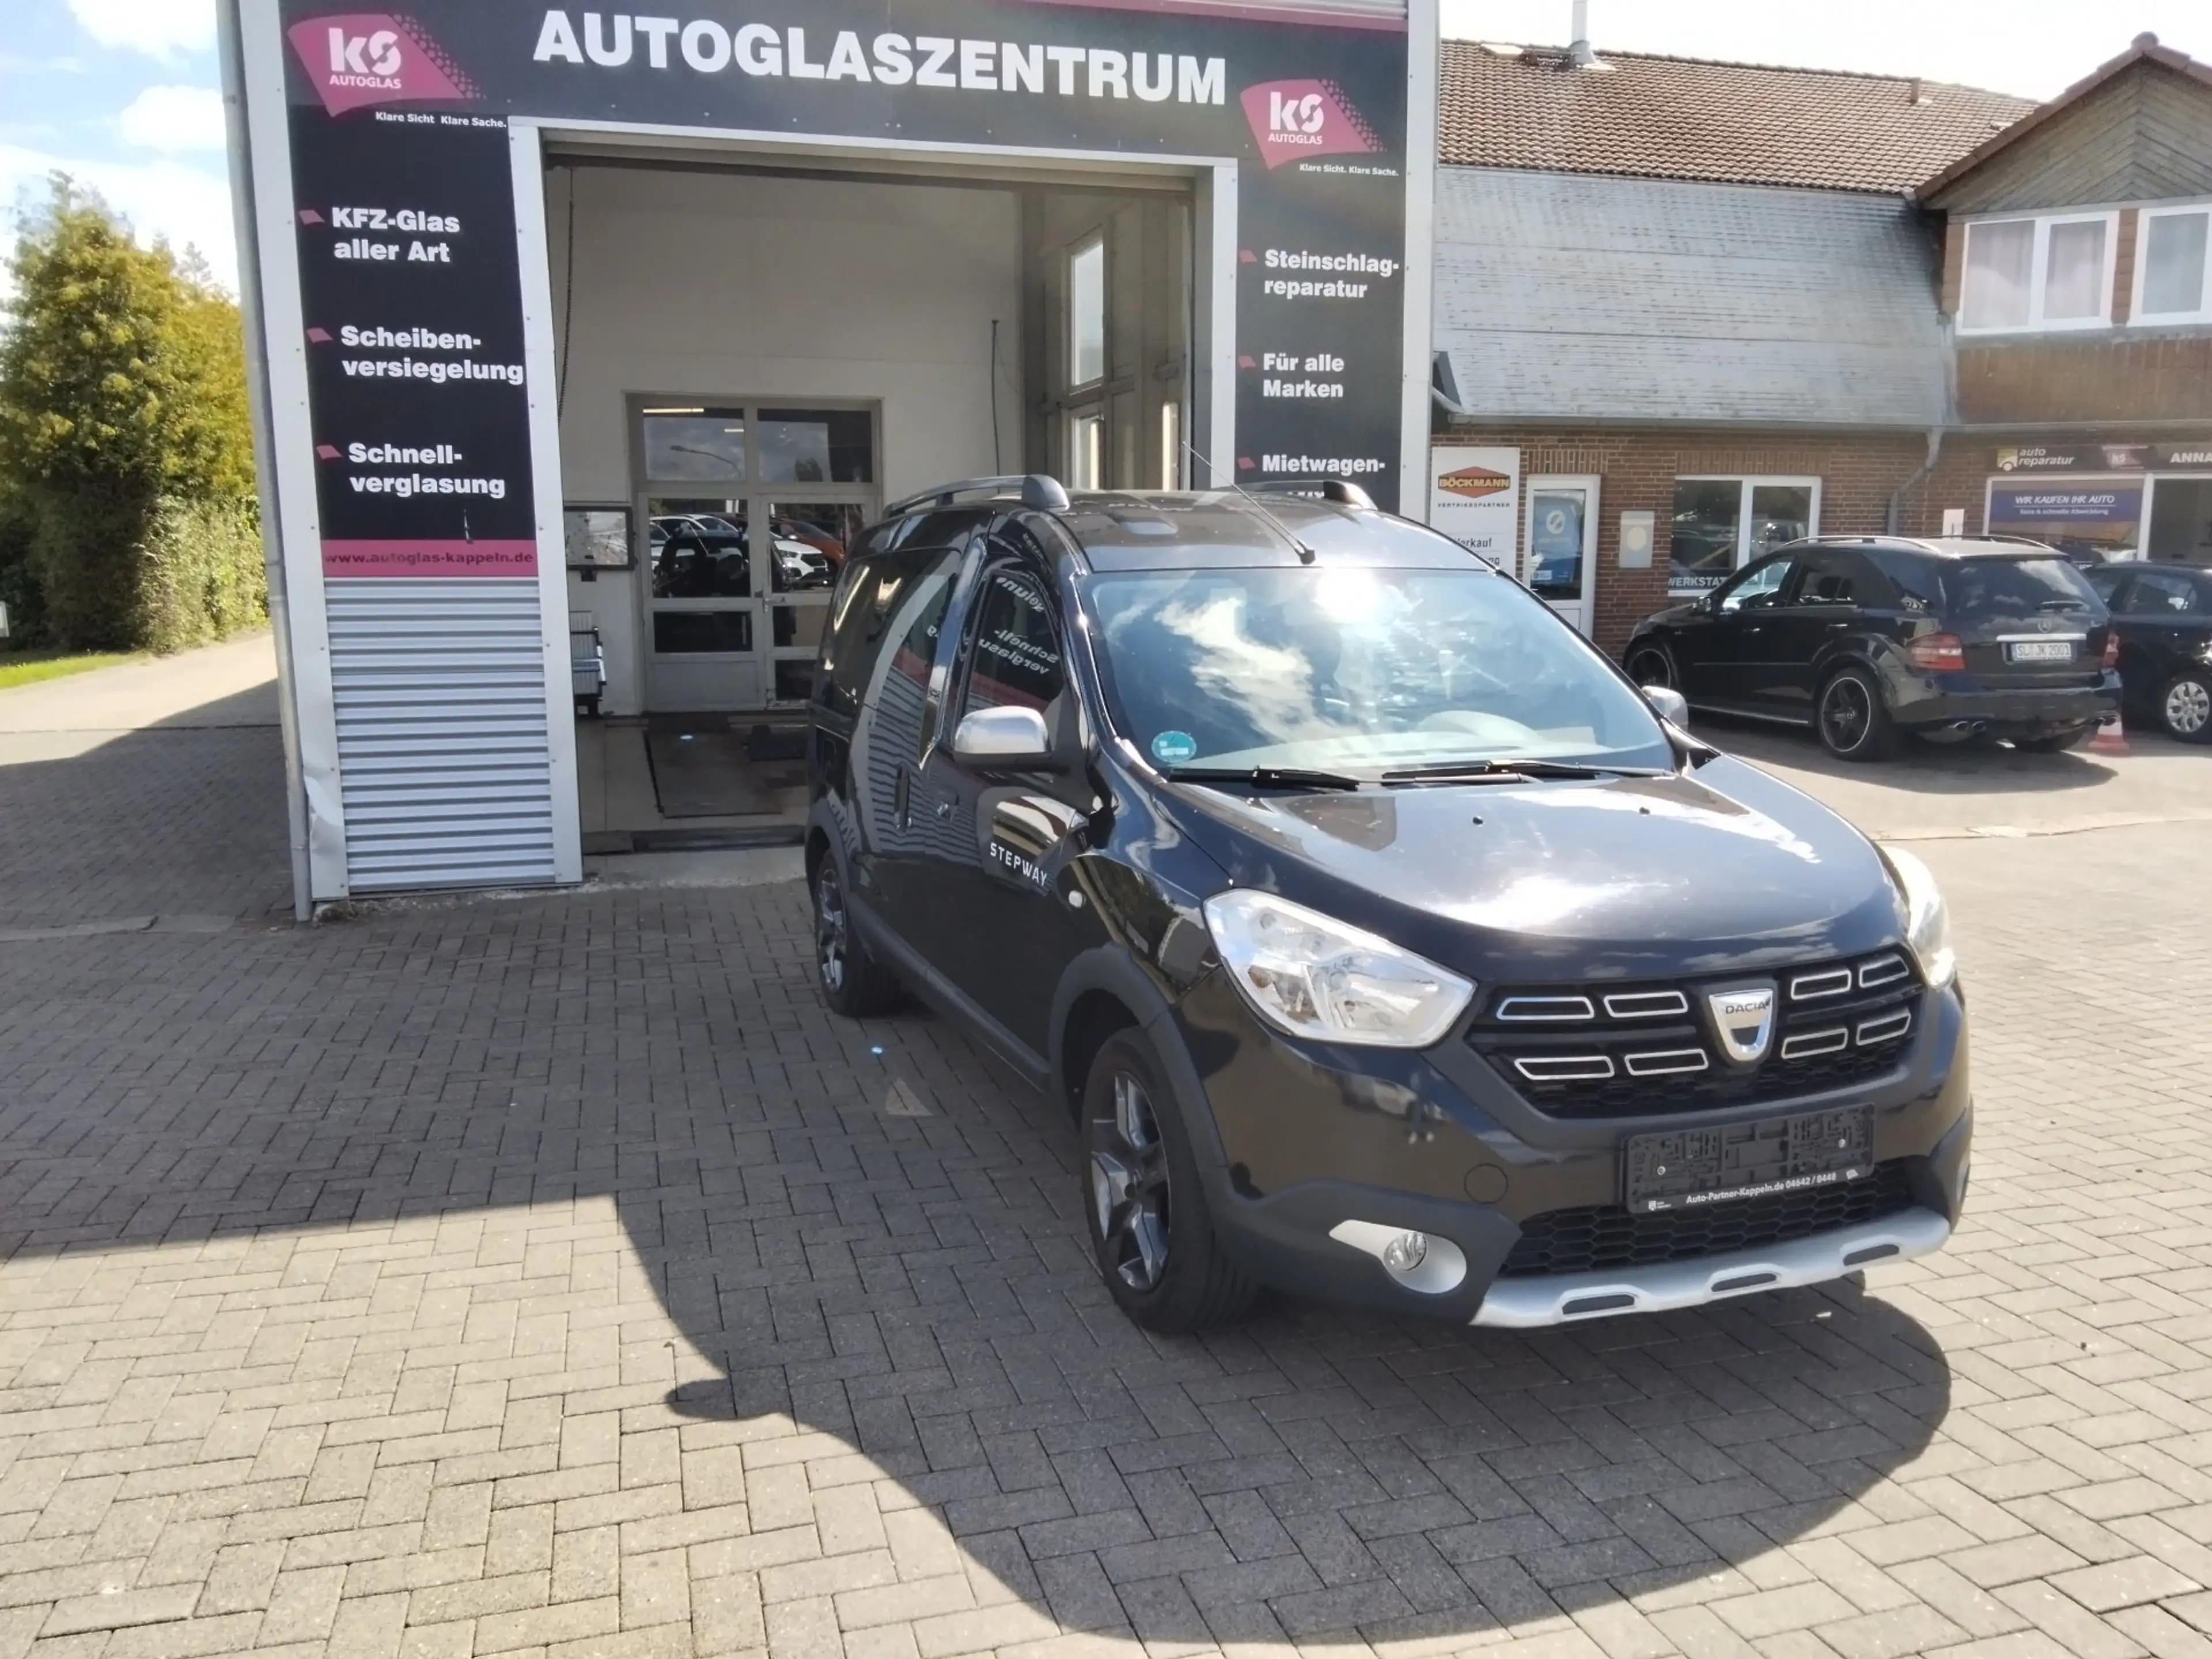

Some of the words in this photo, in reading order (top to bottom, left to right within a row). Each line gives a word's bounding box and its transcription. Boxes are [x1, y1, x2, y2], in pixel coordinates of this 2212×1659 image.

[533, 10, 1225, 105] AUTOGLASZENTRUM
[329, 75, 401, 89] AUTOGLAS
[375, 112, 404, 123] Klare
[441, 115, 469, 126] Klare
[472, 117, 506, 128] Sache.
[1268, 133, 1323, 145] AUTOGLAS
[1300, 164, 1321, 172] Klare
[1324, 165, 1346, 173] Sicht.
[1349, 166, 1370, 175] Klare
[1372, 168, 1399, 176] Sache.
[332, 208, 460, 233] KFZ-Glas
[334, 239, 399, 261] aller
[408, 241, 450, 262] Art
[1265, 249, 1399, 276] Steinschlag-
[1265, 279, 1368, 298] reparatur
[341, 325, 481, 350] Scheiben-
[342, 357, 523, 385] versiegelung
[1264, 353, 1298, 371] Für
[1305, 354, 1344, 372] alle
[1263, 380, 1343, 397] Marken
[349, 443, 462, 464] Schnell-
[2018, 456, 2074, 466] reparatur
[2020, 448, 2046, 456] auto
[1262, 455, 1385, 476] Mietwagen-
[350, 474, 506, 498] verglasung
[1439, 477, 1509, 487] BÖCKMANN
[2015, 495, 2032, 504] WIR
[2035, 495, 2069, 503] KAUFEN
[2071, 495, 2086, 503] IHR
[2088, 495, 2115, 503] AUTO
[1454, 537, 1492, 547] erkauf
[325, 551, 533, 566] www.autoglas-kappeln.de
[990, 842, 1048, 887] STEPWAY
[1726, 1002, 1766, 1014] DACIA
[1686, 1181, 1784, 1204] Auto-Partner-Kappeln.de
